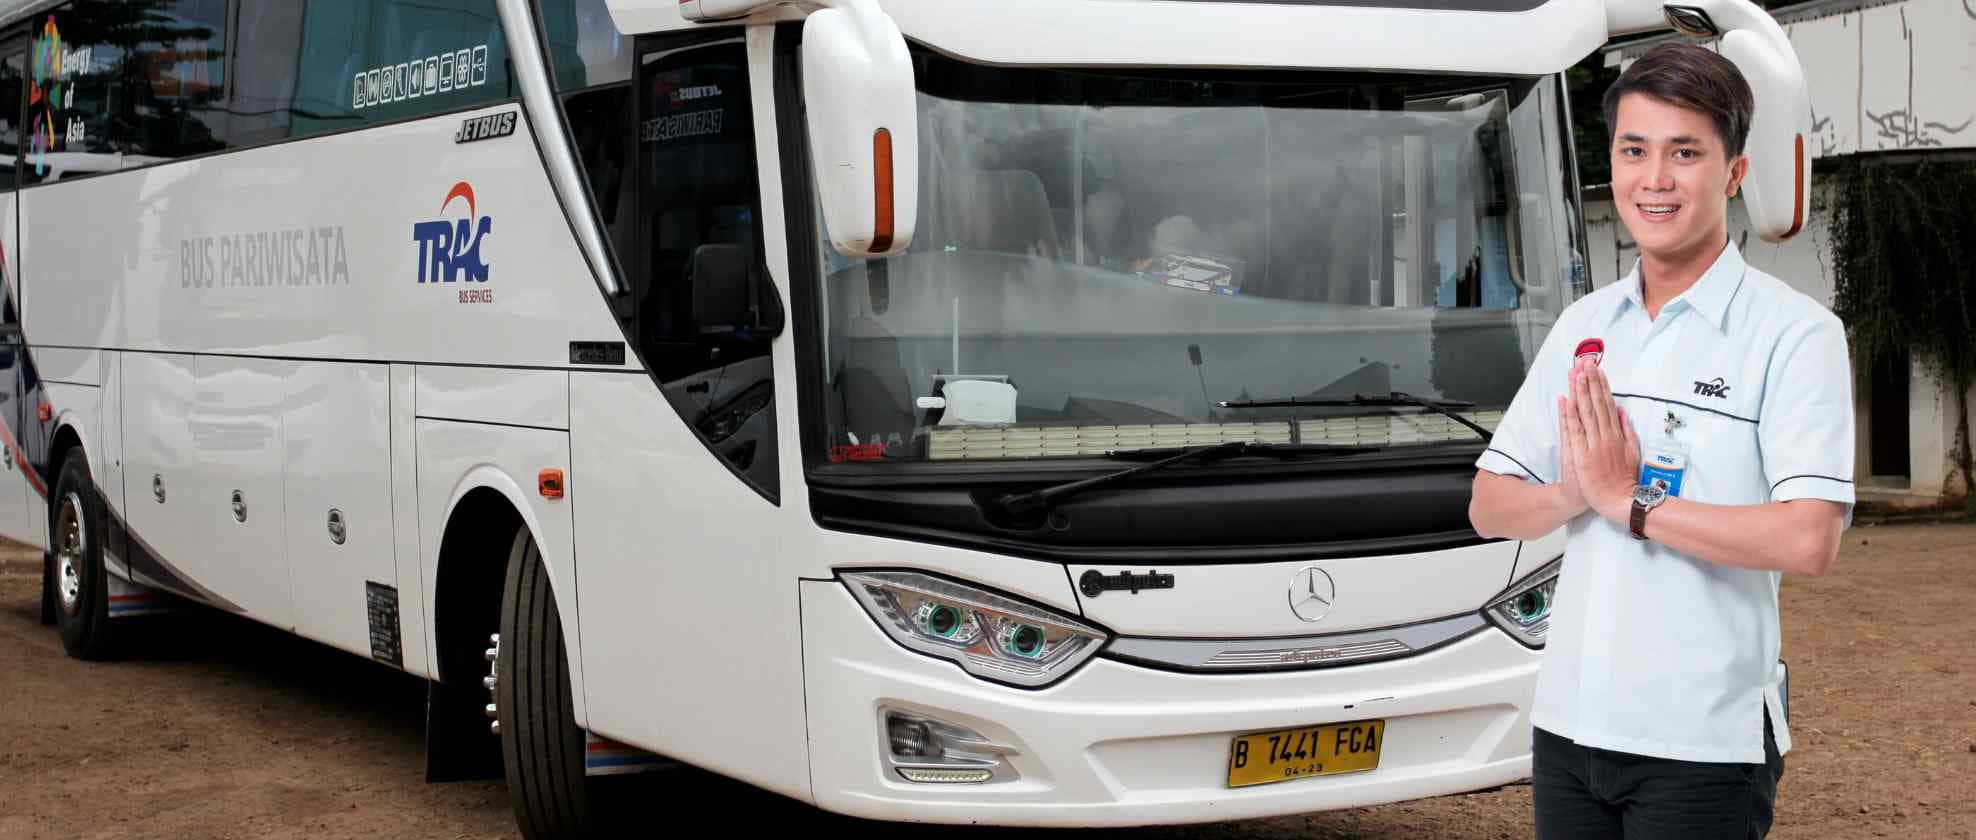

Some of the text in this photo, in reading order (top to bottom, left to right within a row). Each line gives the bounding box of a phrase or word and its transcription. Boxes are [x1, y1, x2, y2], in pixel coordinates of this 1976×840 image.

[62, 47, 91, 76] Energy
[64, 82, 75, 109] of
[65, 115, 85, 144] Asia
[454, 111, 517, 144] JETBUS
[180, 225, 350, 289] BUS PARIWISATA
[413, 215, 492, 283] TRAC
[458, 288, 493, 304] BUS SERVICES
[1693, 380, 1731, 400] TRAC
[1235, 725, 1376, 769] B 7441 FGA
